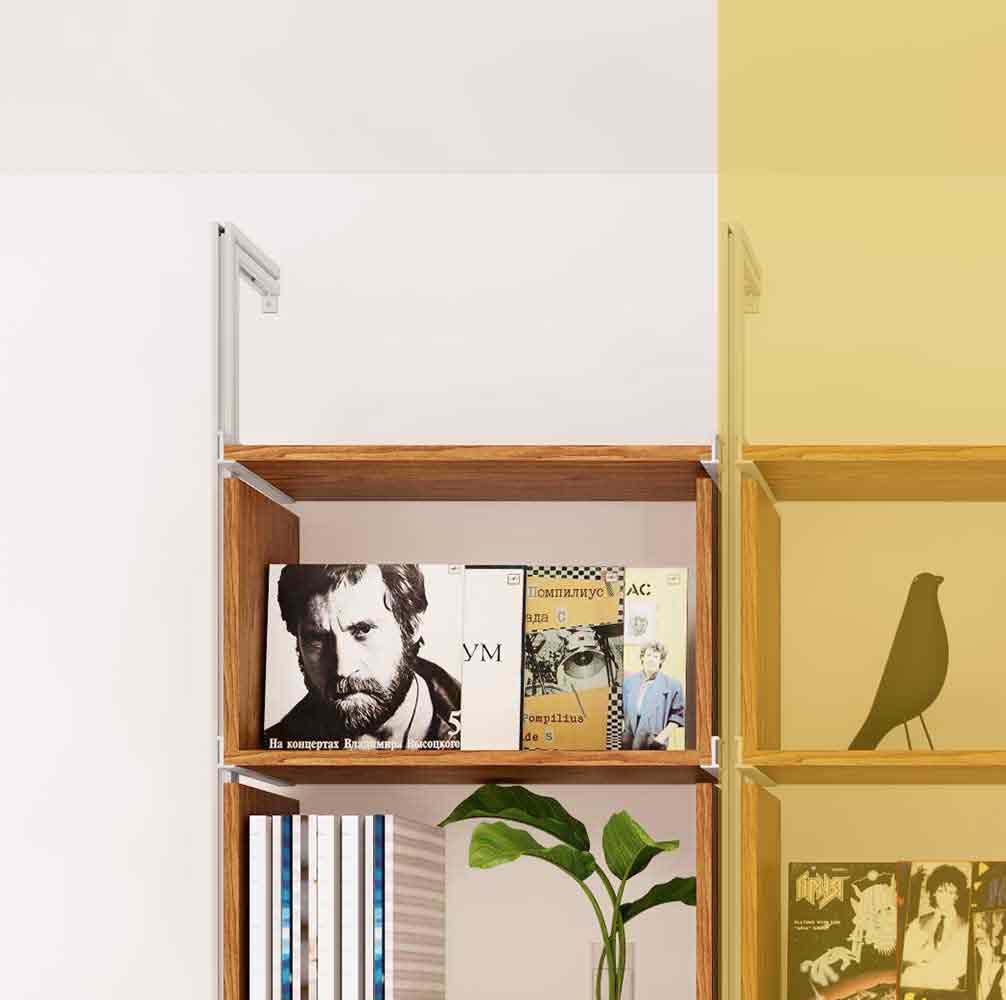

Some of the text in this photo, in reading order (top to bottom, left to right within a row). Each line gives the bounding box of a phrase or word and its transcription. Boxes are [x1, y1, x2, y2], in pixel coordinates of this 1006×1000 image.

[447, 710, 461, 737] 5
[269, 738, 283, 749] На
[286, 740, 340, 750] концертах
